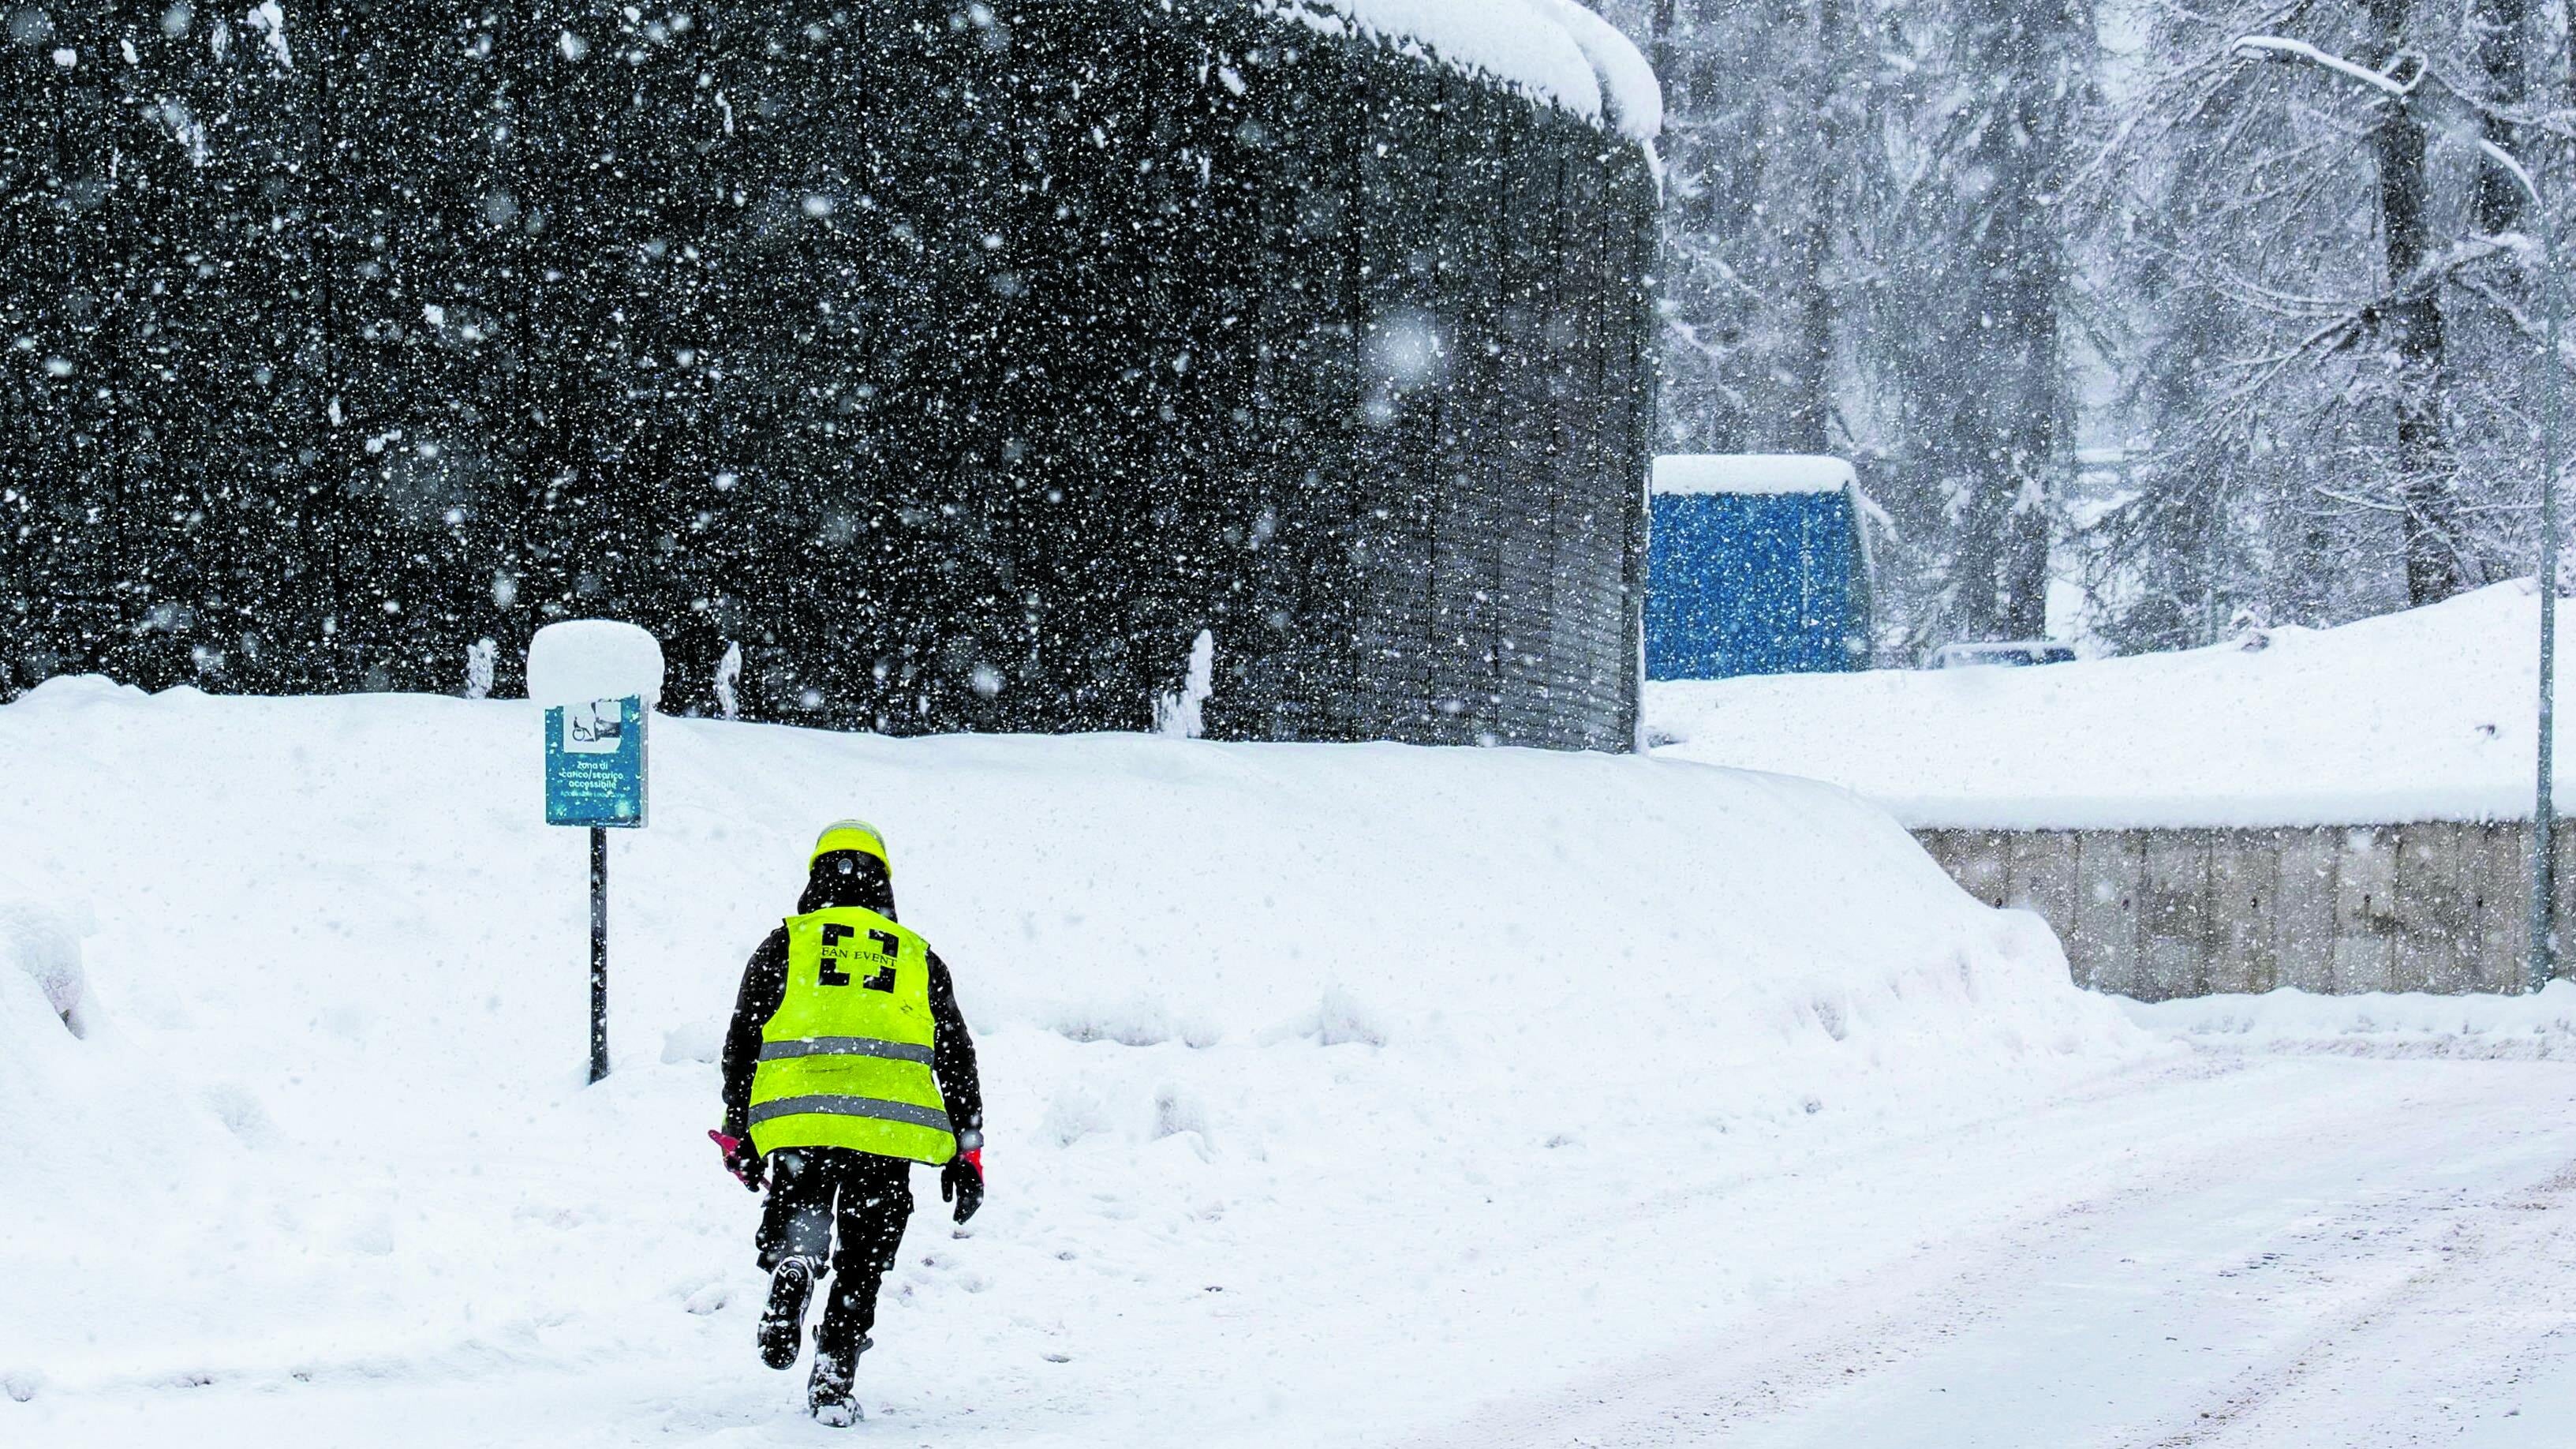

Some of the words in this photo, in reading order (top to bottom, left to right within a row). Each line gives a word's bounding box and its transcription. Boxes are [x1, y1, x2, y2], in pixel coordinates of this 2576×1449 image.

[600, 761, 608, 769] di
[569, 780, 617, 788] accessibile
[821, 947, 848, 958] FAN
[854, 951, 897, 967] EVENT
